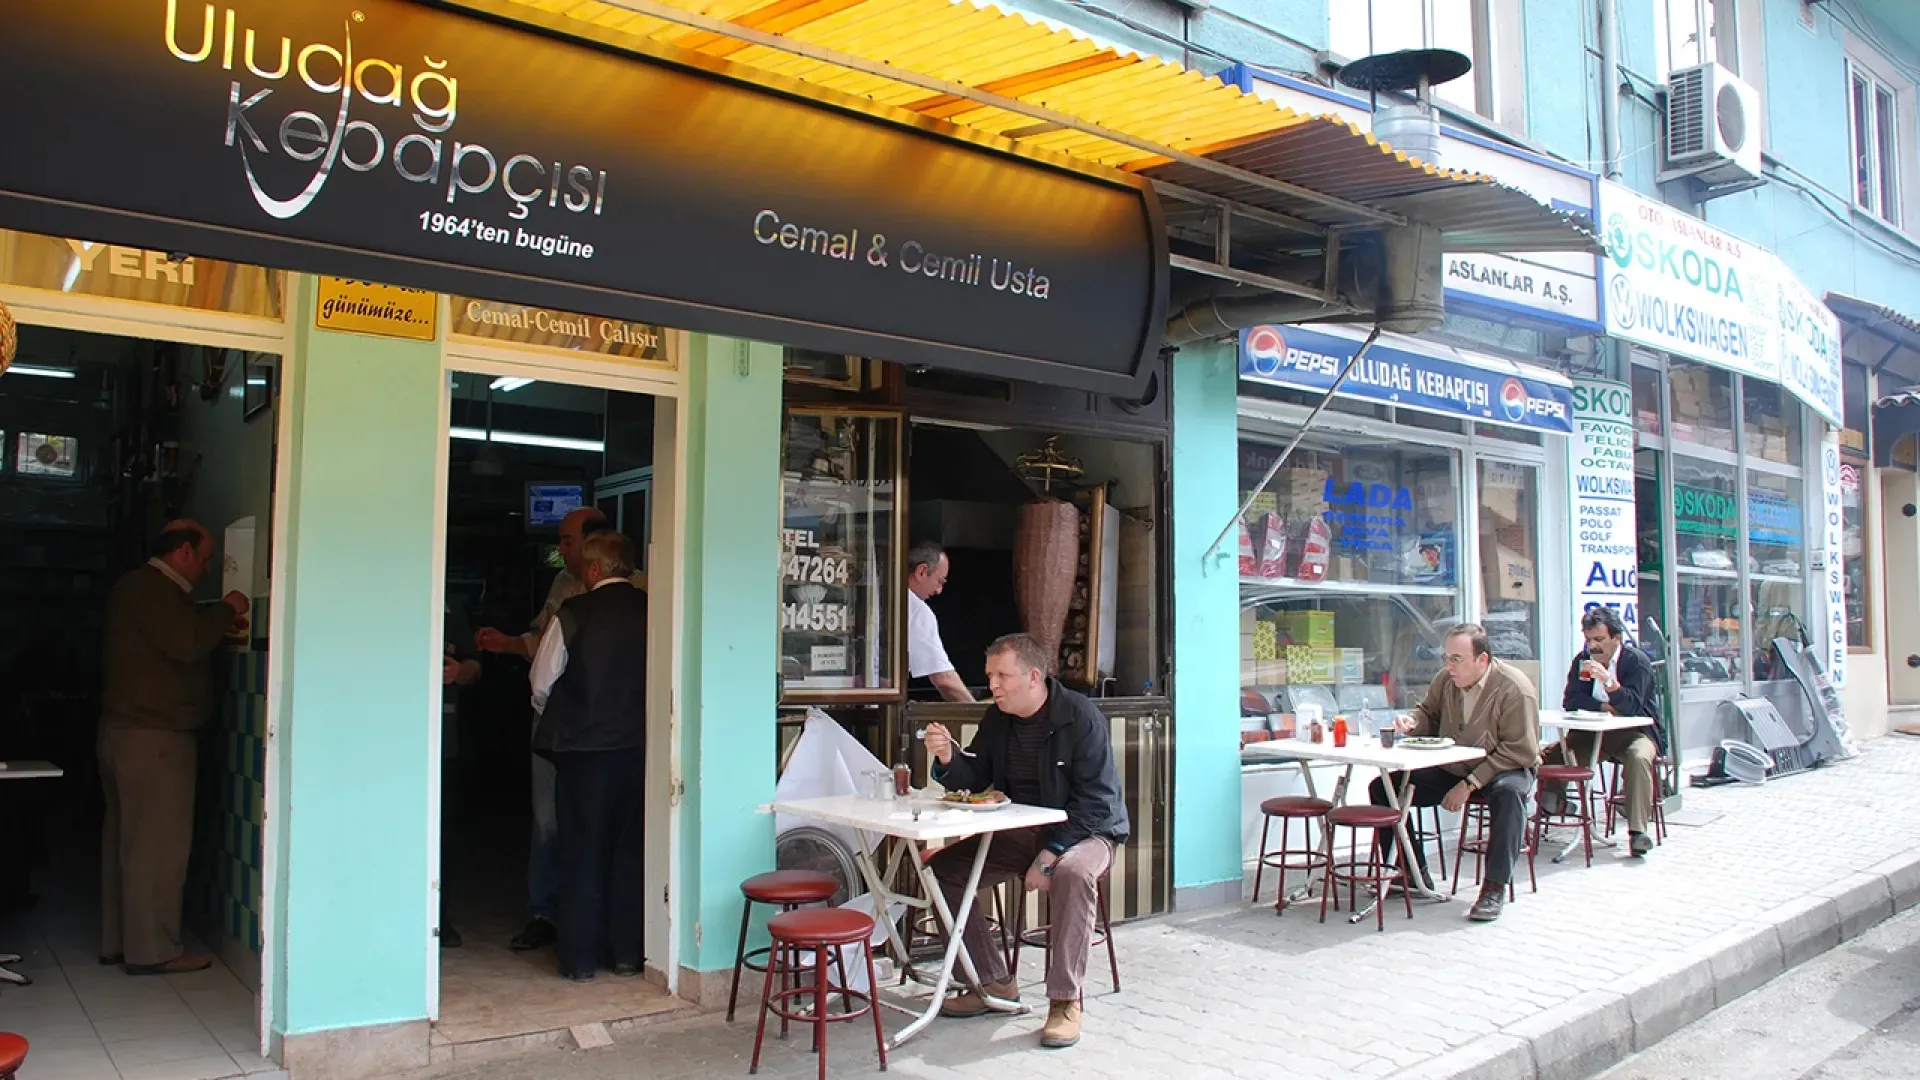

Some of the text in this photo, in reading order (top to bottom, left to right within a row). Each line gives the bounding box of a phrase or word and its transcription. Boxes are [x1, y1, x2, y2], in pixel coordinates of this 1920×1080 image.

[165, 0, 458, 132] Uludağ
[1638, 204, 1662, 225] OTO
[419, 211, 595, 259] 1964'ten bugüne
[753, 209, 1050, 299] Cemal & Cemil Usta
[1449, 259, 1573, 305] ASLANLAR A.Ş.
[1636, 231, 1744, 303] SKODA
[323, 294, 430, 325] günümüze...
[467, 300, 658, 348] Cemal-Cemil Çalışır
[1635, 291, 1749, 358] WOLKSWAGEN
[1283, 347, 1340, 376] PEPSI
[1346, 354, 1412, 391] ULUDAĞ
[1416, 368, 1489, 411] KEBAPÇISI
[1322, 476, 1413, 511] LADA
[1579, 505, 1622, 517] PASSAT
[1685, 490, 1736, 521] SKODA
[783, 528, 820, 548] TEL
[1579, 518, 1613, 529] POLO
[1579, 530, 1612, 542] GOLF
[783, 554, 849, 585] 47264
[1826, 491, 1843, 683] WOLKSWAGEN
